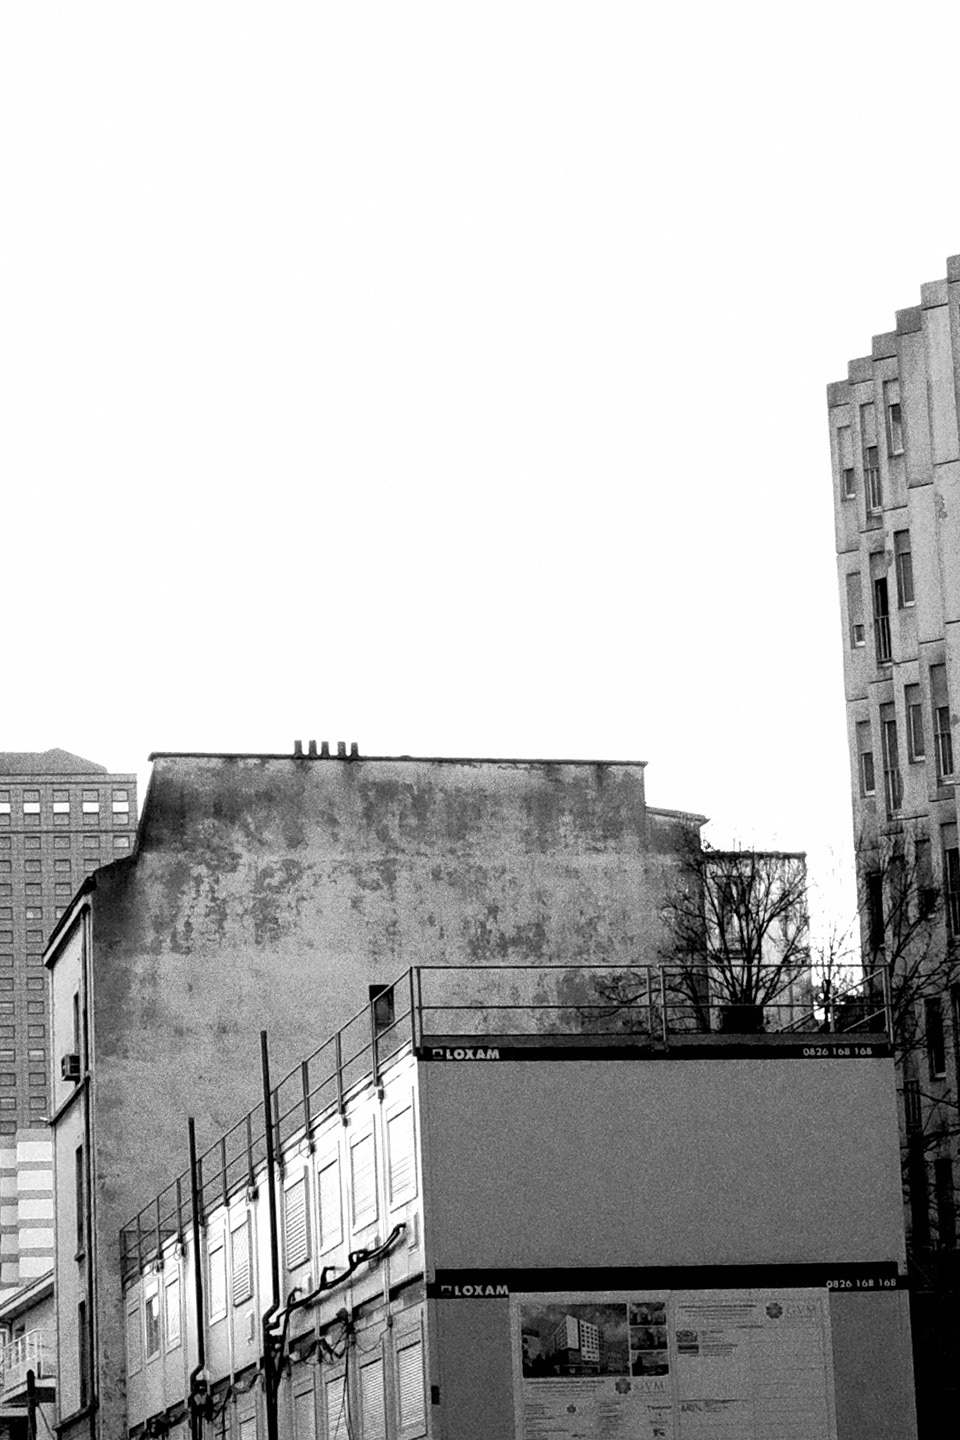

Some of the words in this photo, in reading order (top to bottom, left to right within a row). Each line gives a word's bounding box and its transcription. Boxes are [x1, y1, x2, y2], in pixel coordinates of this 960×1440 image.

[446, 1048, 501, 1061] LOXAM
[832, 1046, 851, 1056] 168
[855, 1046, 873, 1056] 168
[454, 1284, 510, 1298] LOXAM
[826, 1279, 853, 1289] 0826
[856, 1278, 875, 1288] 168
[878, 1277, 897, 1287] 168
